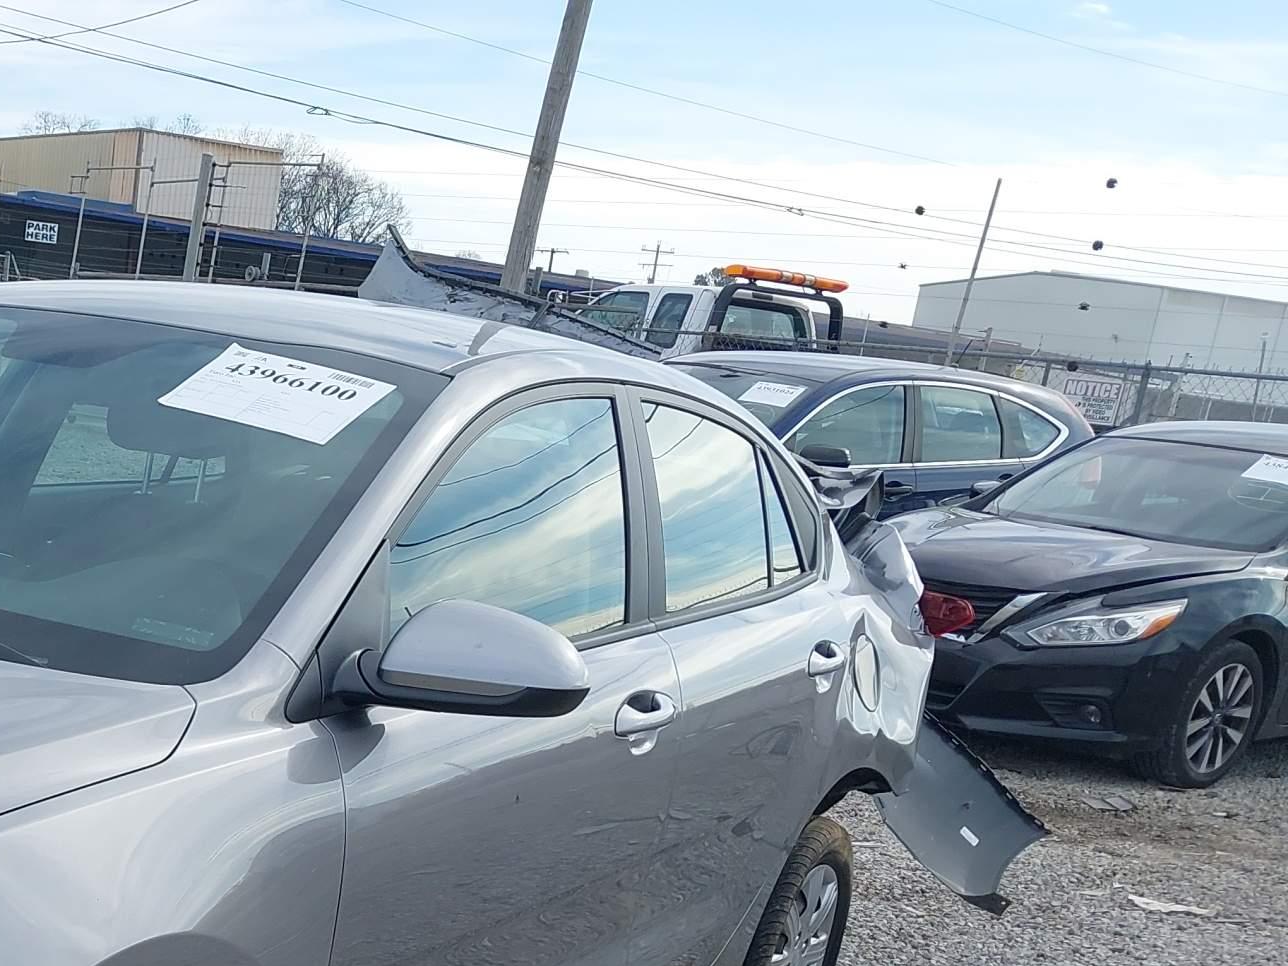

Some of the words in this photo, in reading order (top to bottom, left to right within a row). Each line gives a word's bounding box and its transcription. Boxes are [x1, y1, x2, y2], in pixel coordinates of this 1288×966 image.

[27, 222, 57, 234] PARK
[26, 231, 56, 243] HERE
[224, 362, 358, 401] 43966100
[1065, 379, 1121, 398] NOTICE
[1087, 402, 1114, 411] PROTECTED
[1091, 397, 1115, 406] PROPERTY
